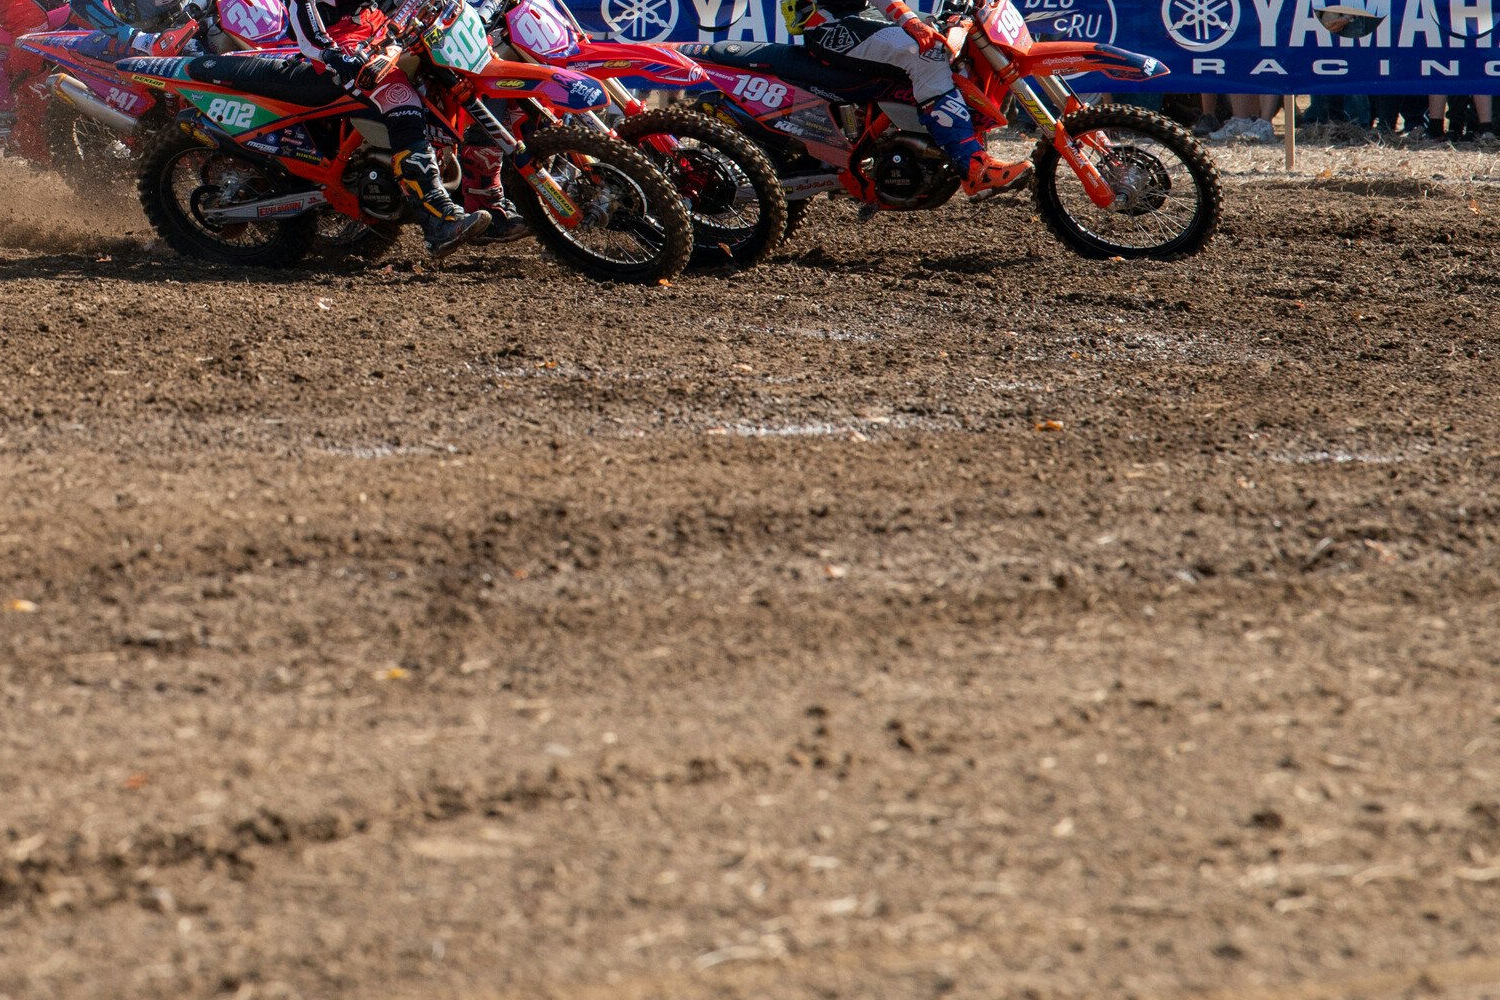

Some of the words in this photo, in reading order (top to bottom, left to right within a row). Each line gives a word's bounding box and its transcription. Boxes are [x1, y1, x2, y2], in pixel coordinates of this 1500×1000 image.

[441, 15, 489, 71] 802
[1144, 58, 1157, 77] KTM
[133, 75, 165, 87] DUNLOP
[732, 73, 788, 108] 198
[106, 87, 138, 111] 347
[206, 98, 256, 128] 802
[774, 121, 804, 136] KTM
[549, 186, 575, 213] DUNLOP
